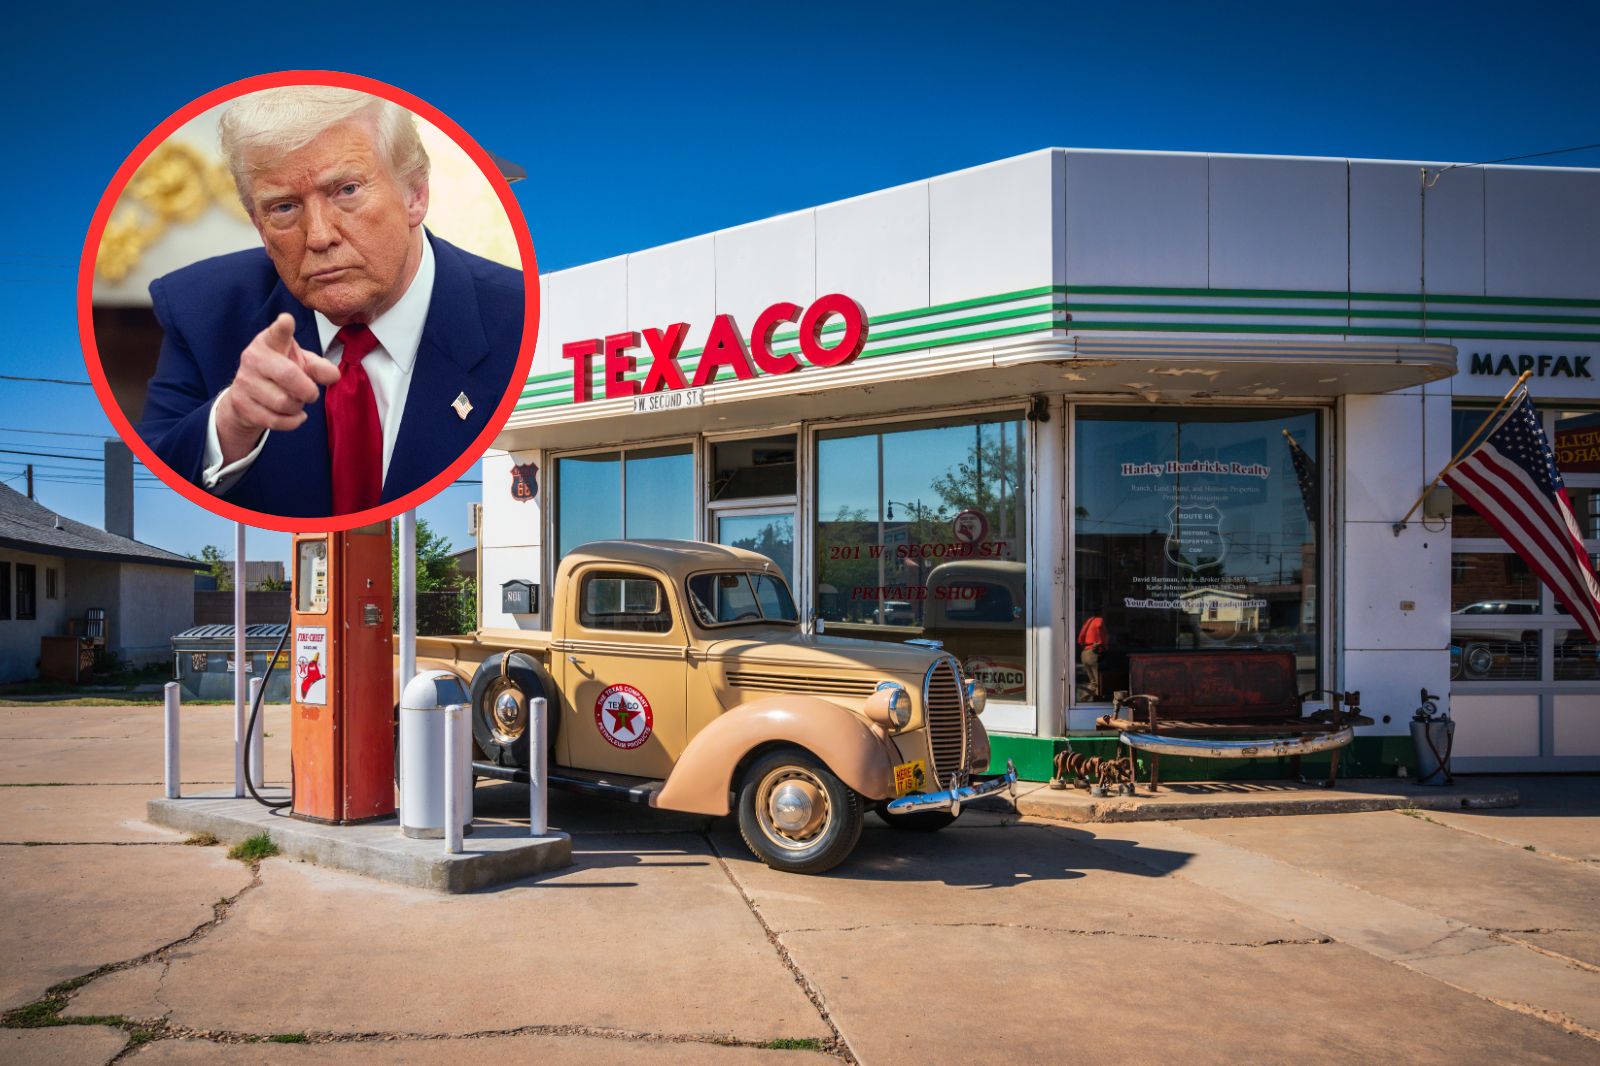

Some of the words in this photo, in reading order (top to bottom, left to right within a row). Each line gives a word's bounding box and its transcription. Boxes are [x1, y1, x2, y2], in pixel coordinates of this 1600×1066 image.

[562, 293, 869, 403] TEXACO
[1470, 353, 1592, 378] MARFAK
[650, 393, 682, 410] SECOND
[1122, 462, 1164, 477] Harley
[1166, 460, 1229, 474] Hendricks
[1230, 462, 1271, 479] Realty
[830, 546, 860, 561] 201
[868, 545, 889, 559] W.
[897, 543, 973, 560] SECOND
[980, 542, 1011, 557] ST.
[851, 586, 928, 601] PRIVATE
[934, 585, 989, 601] SHOP
[1124, 598, 1145, 609] Your
[1146, 598, 1172, 609] Route
[974, 671, 1023, 684] TEXACO
[605, 685, 623, 696] TEXAS
[624, 686, 649, 708] COMPANY
[608, 701, 639, 710] TEXACO
[617, 712, 628, 727] T
[598, 722, 627, 748] PETROLEUM
[627, 726, 651, 748] PRODUCTS
